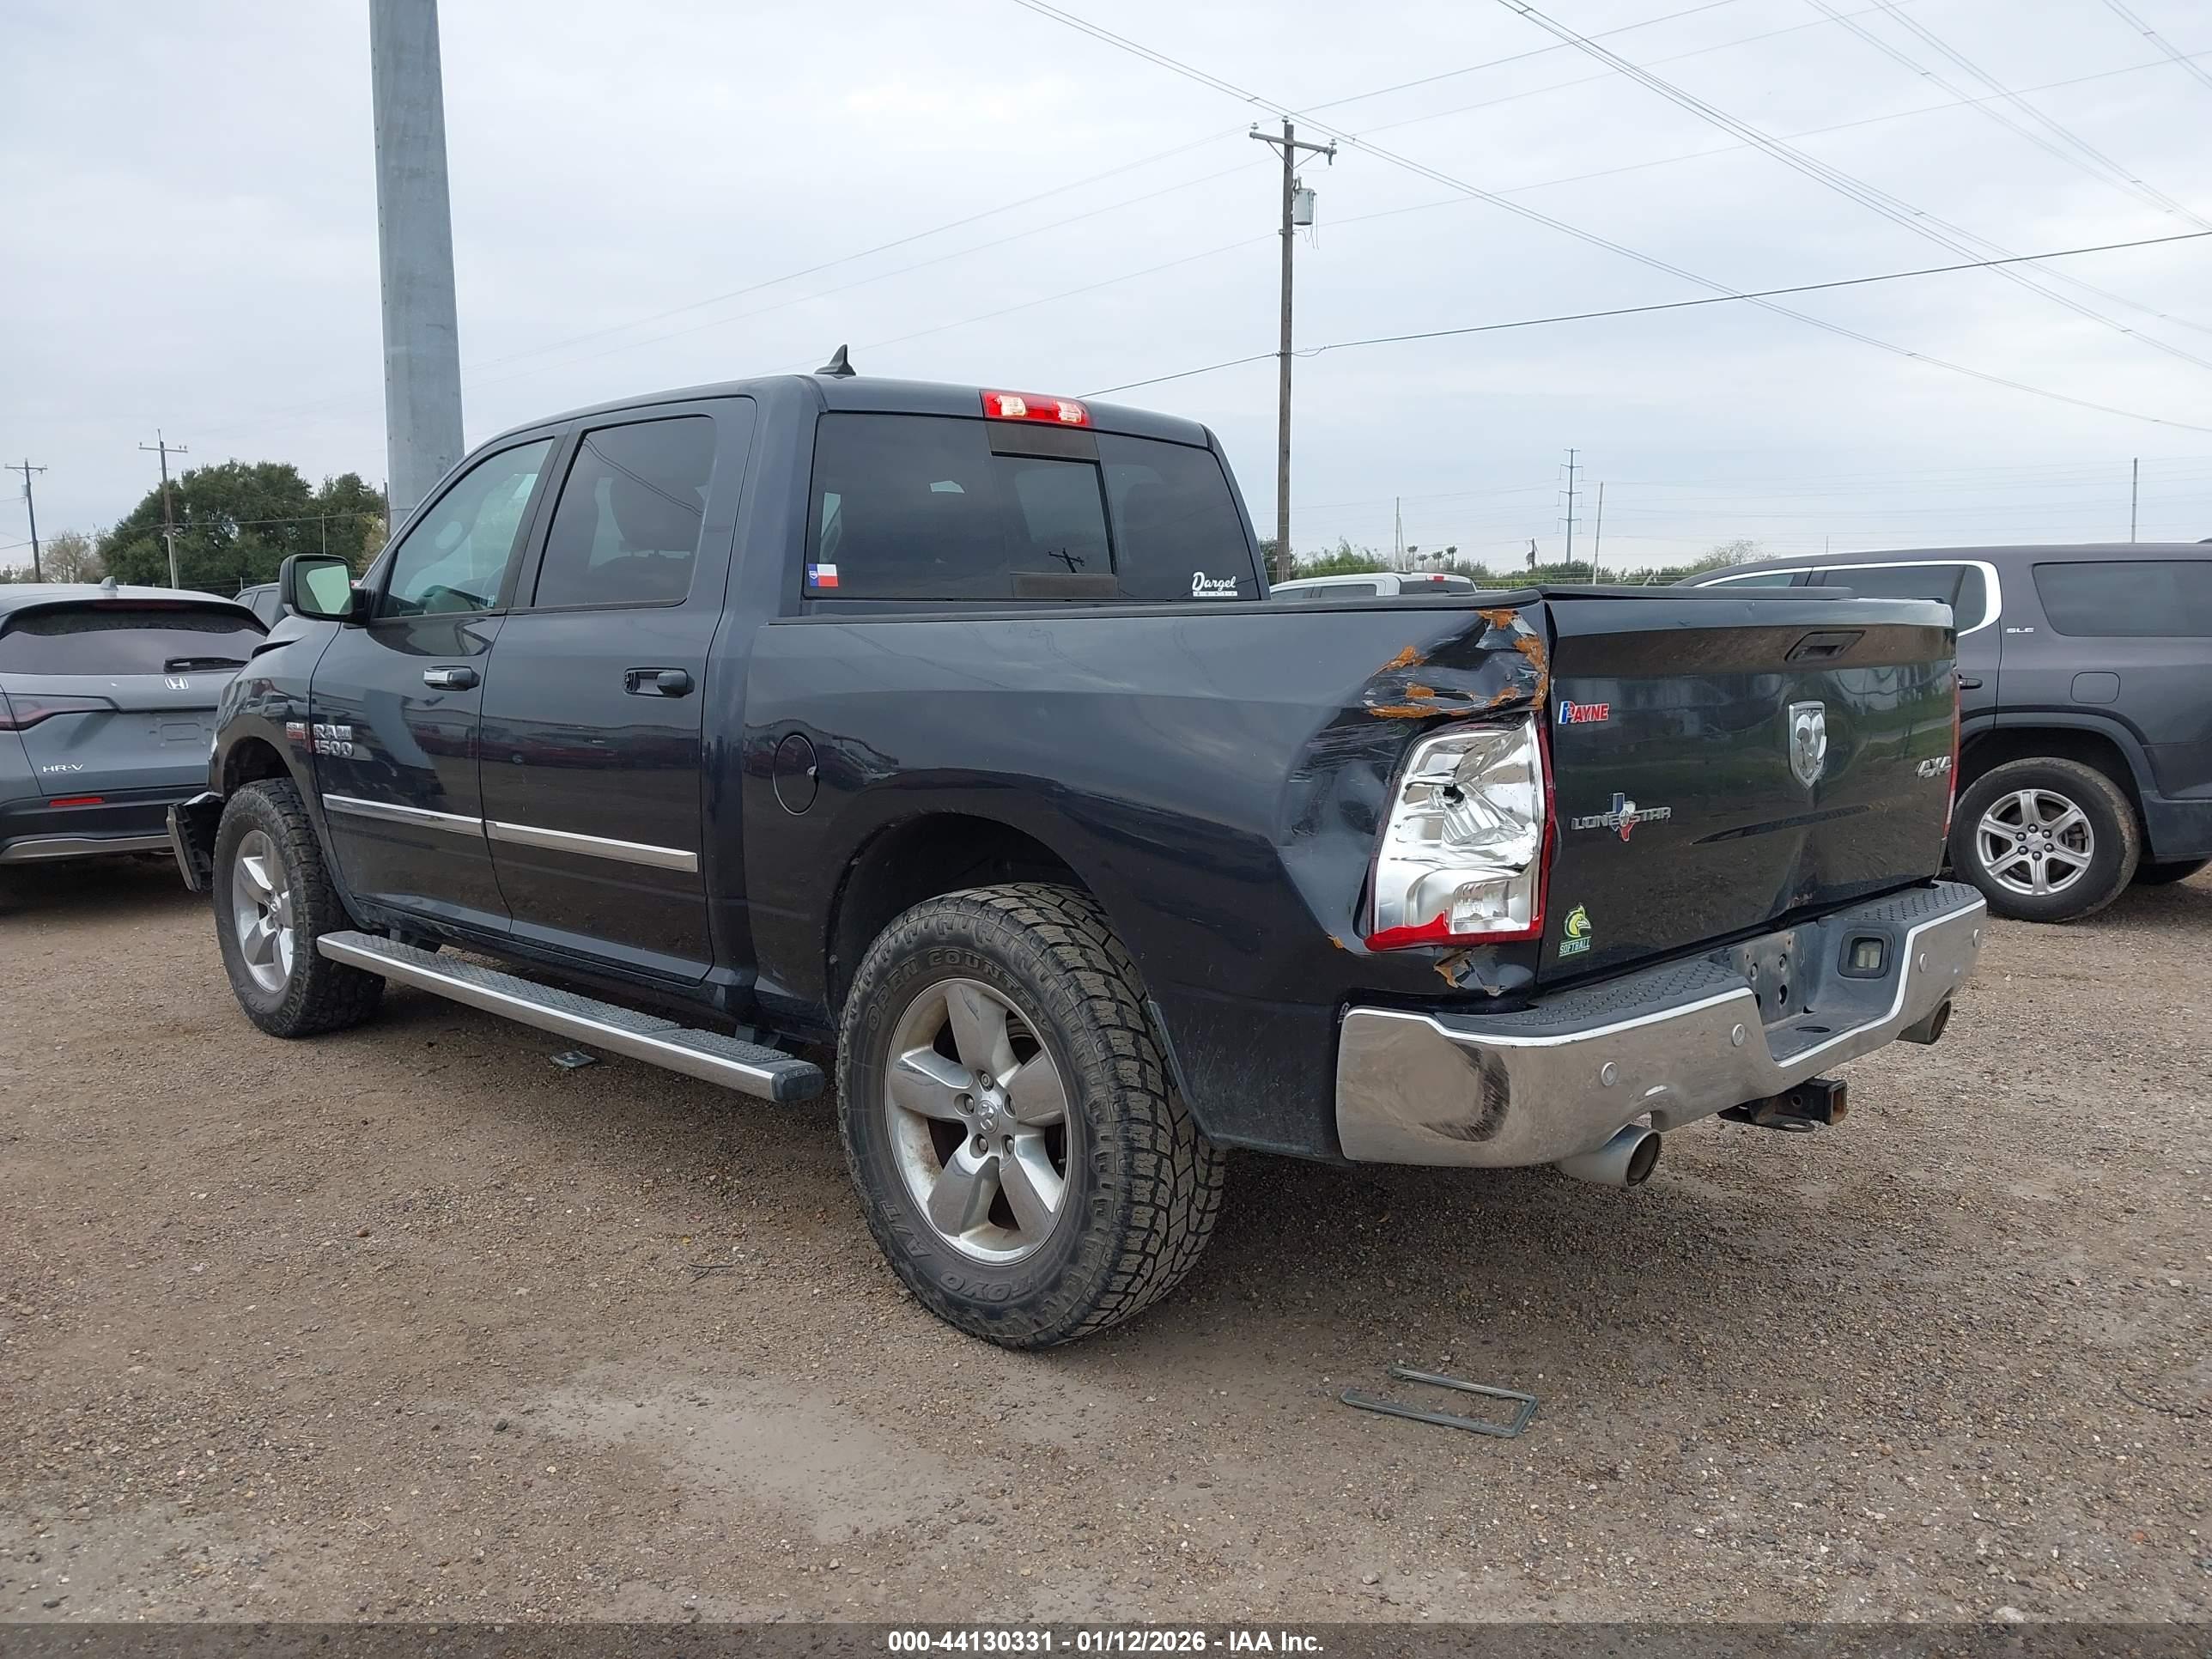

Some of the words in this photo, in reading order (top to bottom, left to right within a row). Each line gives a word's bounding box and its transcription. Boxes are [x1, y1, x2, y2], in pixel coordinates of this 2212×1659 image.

[1192, 571, 1237, 592] Dargel
[1559, 701, 1609, 724] PAYNE
[313, 723, 352, 739] RAM
[314, 739, 353, 757] 1500
[42, 763, 83, 773] HR-V
[1571, 811, 1621, 830] LONE
[1629, 806, 1671, 823] STAR
[1559, 939, 1590, 955] SOFTBALL
[867, 957, 921, 1030] OPEN
